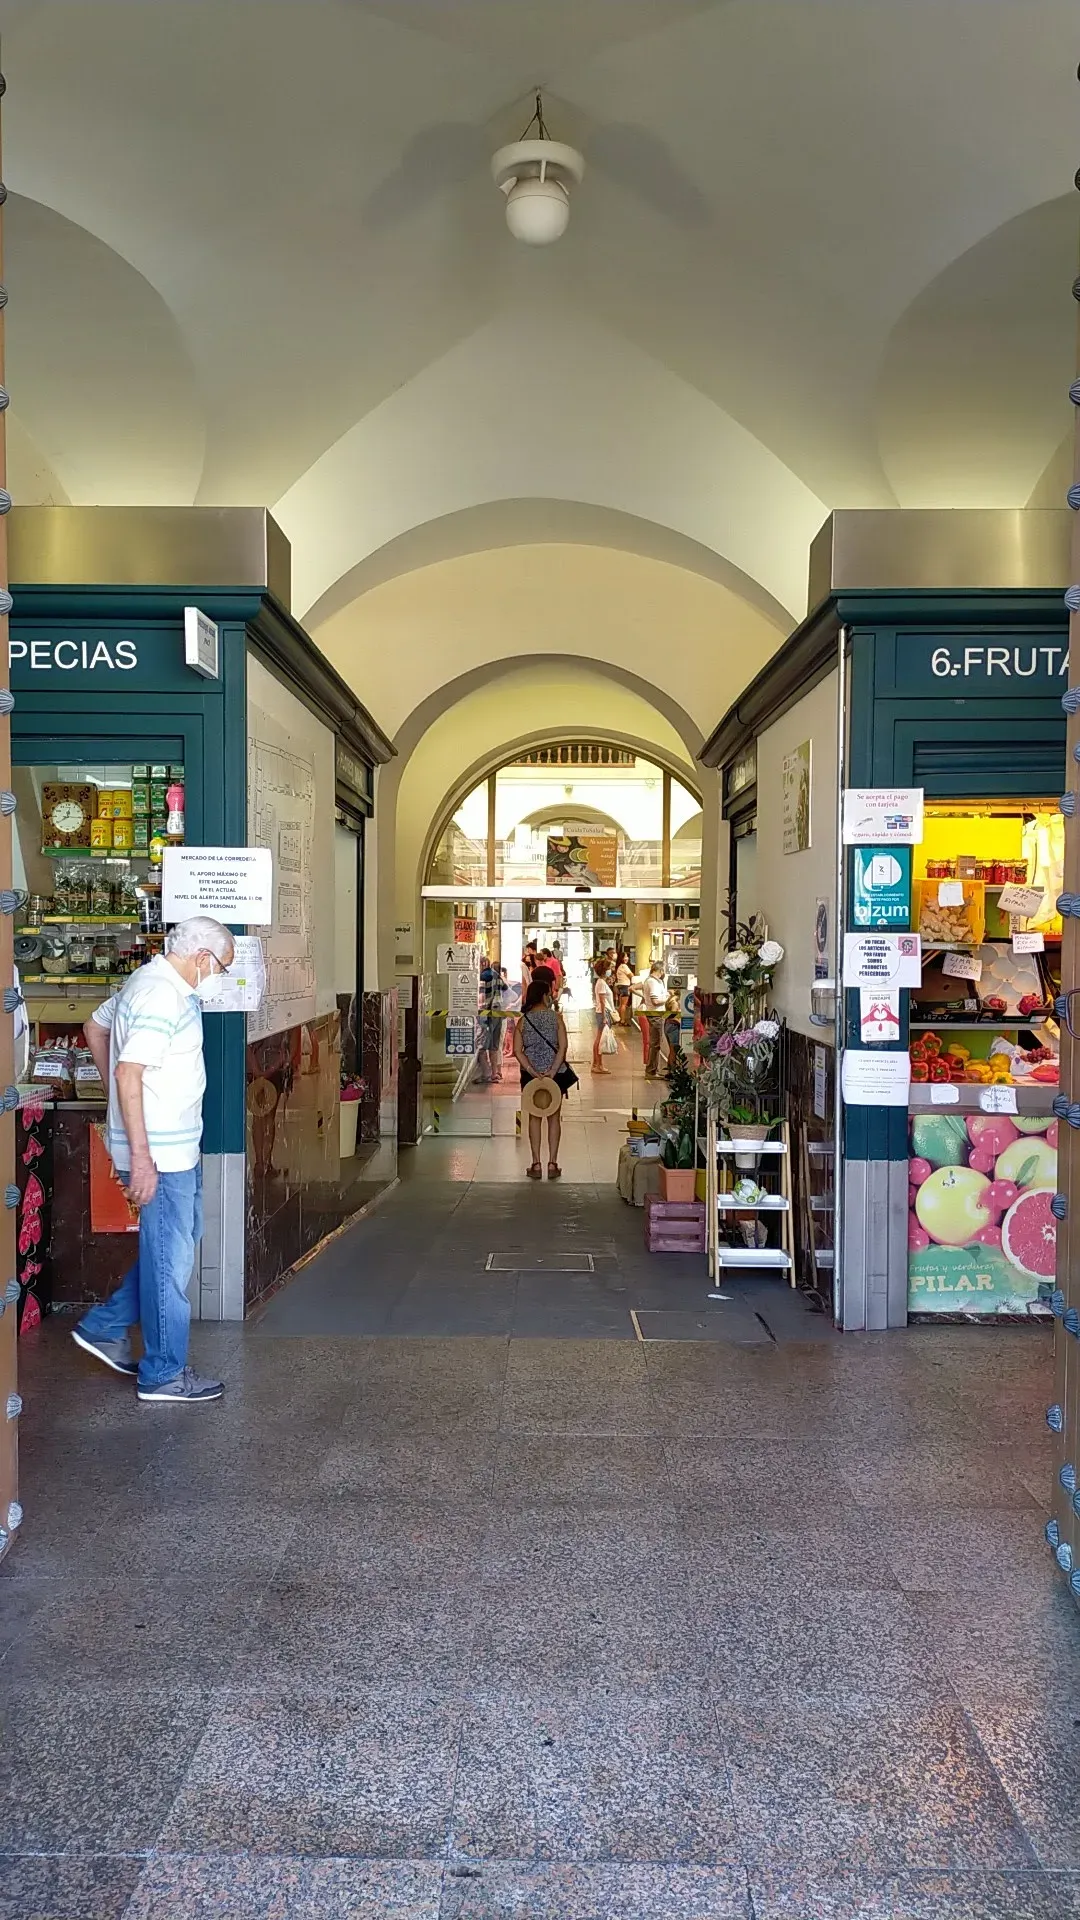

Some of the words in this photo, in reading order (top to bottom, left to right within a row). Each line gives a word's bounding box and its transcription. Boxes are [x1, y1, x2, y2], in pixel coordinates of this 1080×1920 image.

[9, 640, 138, 669] PECIAS
[950, 956, 971, 965] LIMA
[910, 1264, 939, 1272] Frutas
[952, 1262, 995, 1271] verduras
[909, 1274, 995, 1293] PILAR
